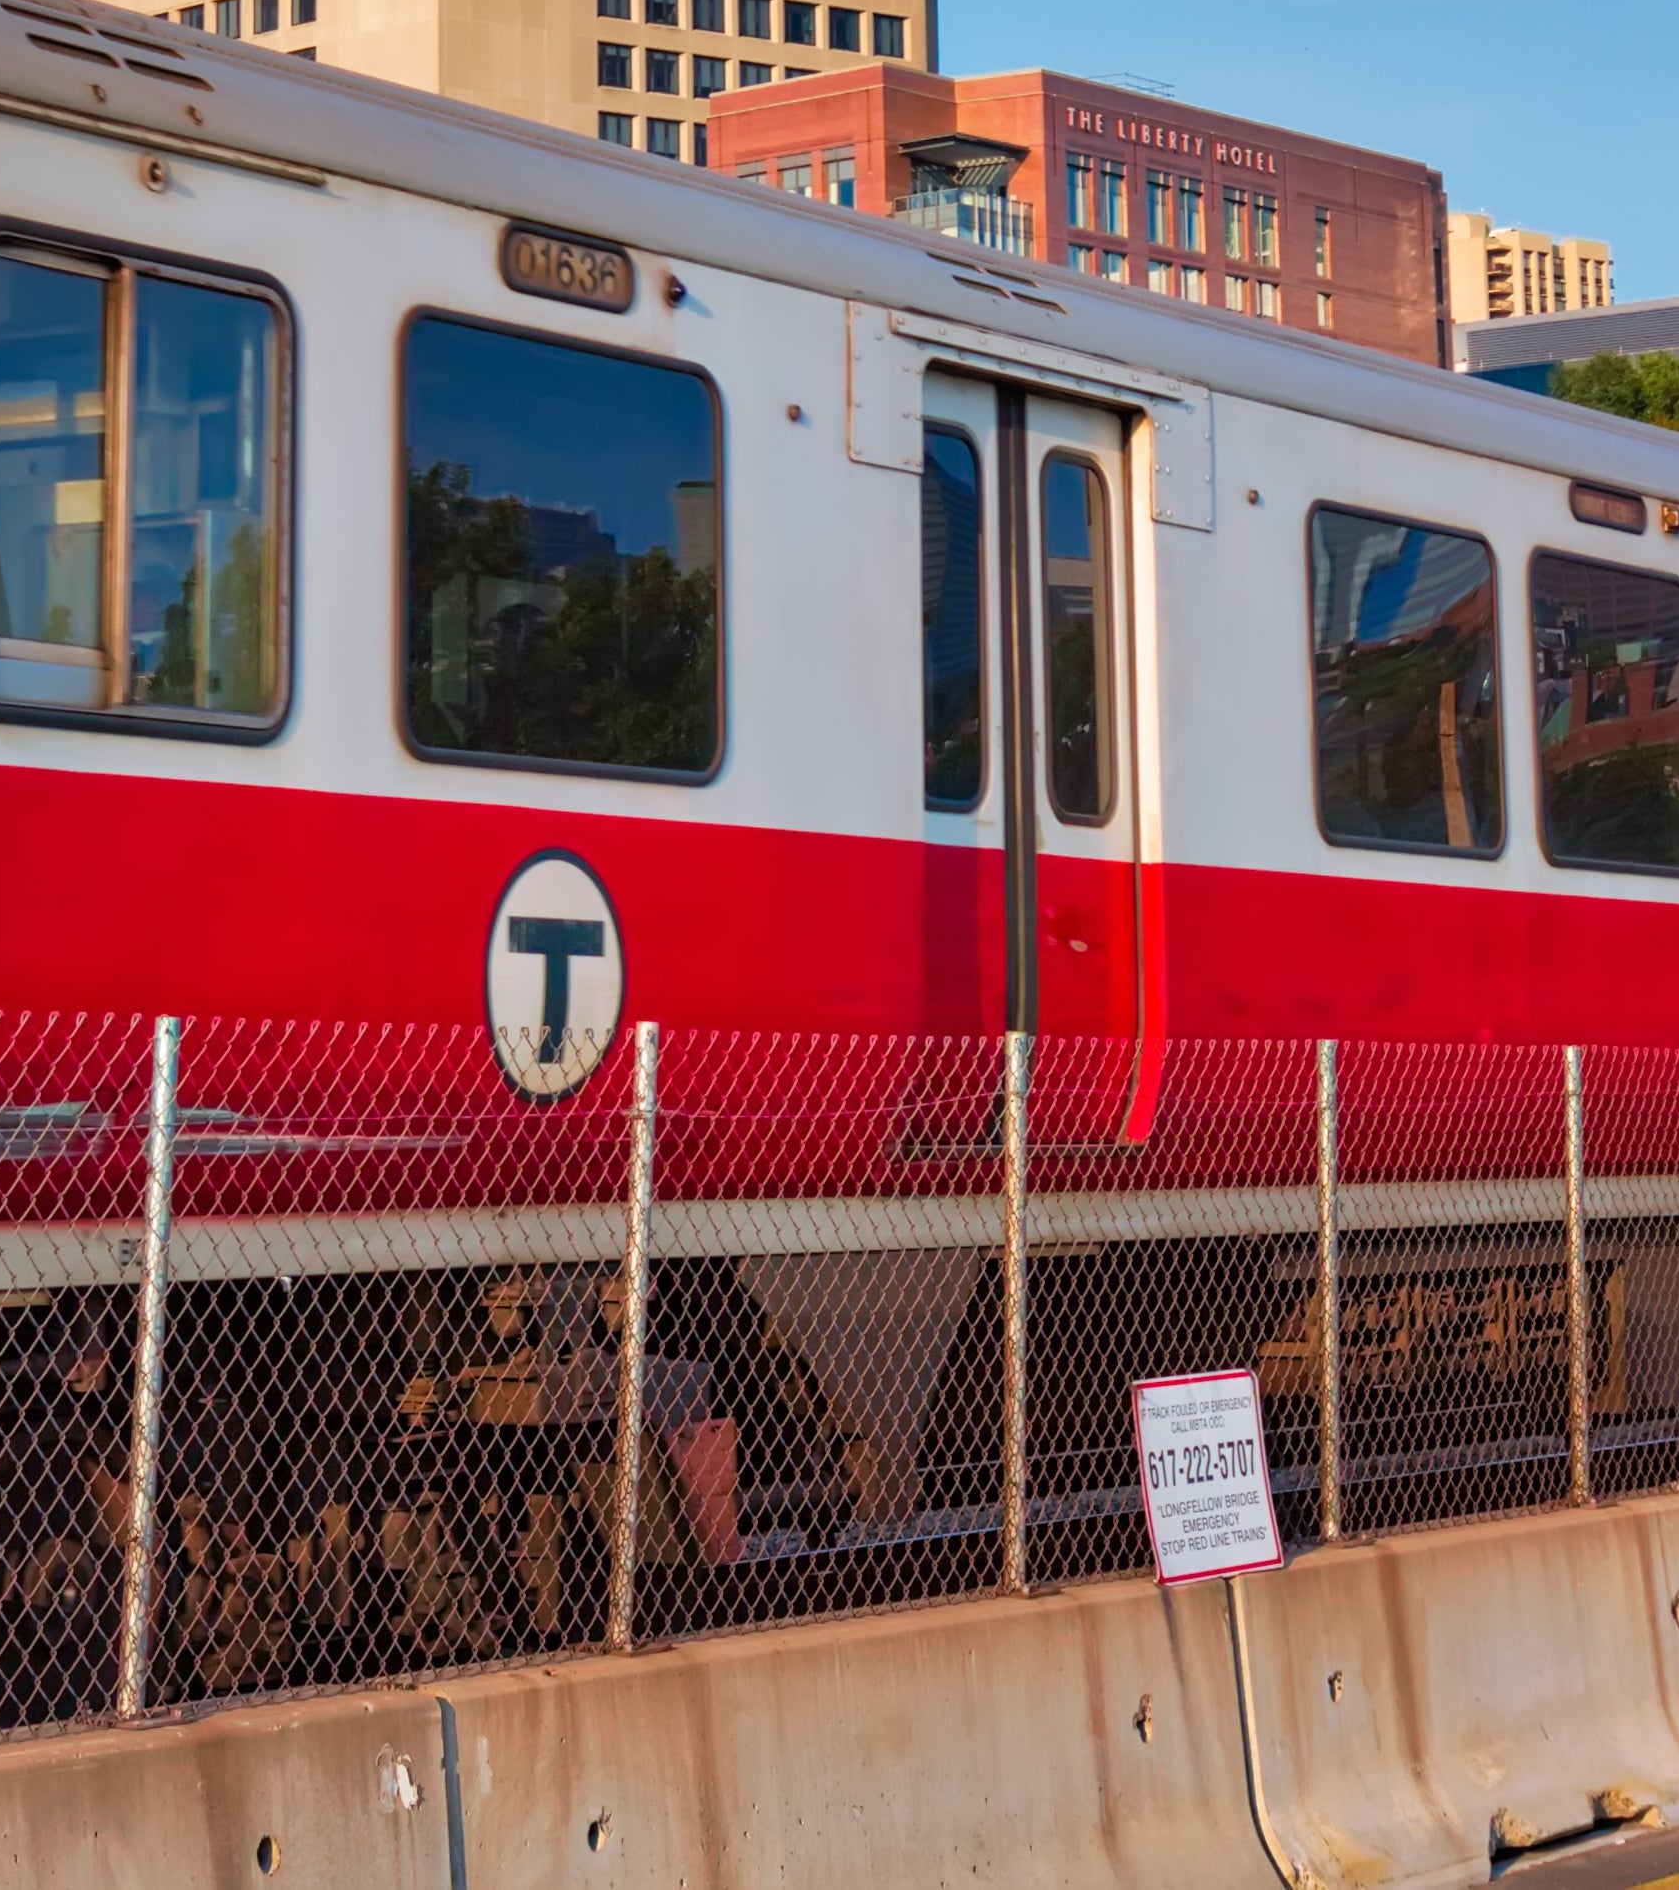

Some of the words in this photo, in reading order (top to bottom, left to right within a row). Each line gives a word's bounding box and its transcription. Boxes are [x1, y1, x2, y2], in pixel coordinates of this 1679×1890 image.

[1066, 107, 1104, 133] THE
[1117, 119, 1203, 157] LIBERTY
[1216, 142, 1276, 174] HOTEL
[516, 236, 618, 296] 01636
[508, 916, 605, 1064] T
[1148, 1406, 1170, 1420] TRACK
[1171, 1402, 1198, 1417] FOULED
[1199, 1400, 1210, 1414] OR
[1211, 1396, 1252, 1412] EMERGENCY
[1171, 1420, 1188, 1434] CALL
[1189, 1417, 1208, 1431] MBTA
[1148, 1438, 1255, 1490] 617-222-5707
[1225, 1491, 1260, 1509] BRIDGE
[1182, 1512, 1240, 1534] EMERGENCY
[1161, 1540, 1186, 1556] STOP
[1188, 1536, 1208, 1551] RED
[1209, 1532, 1230, 1548] LINE
